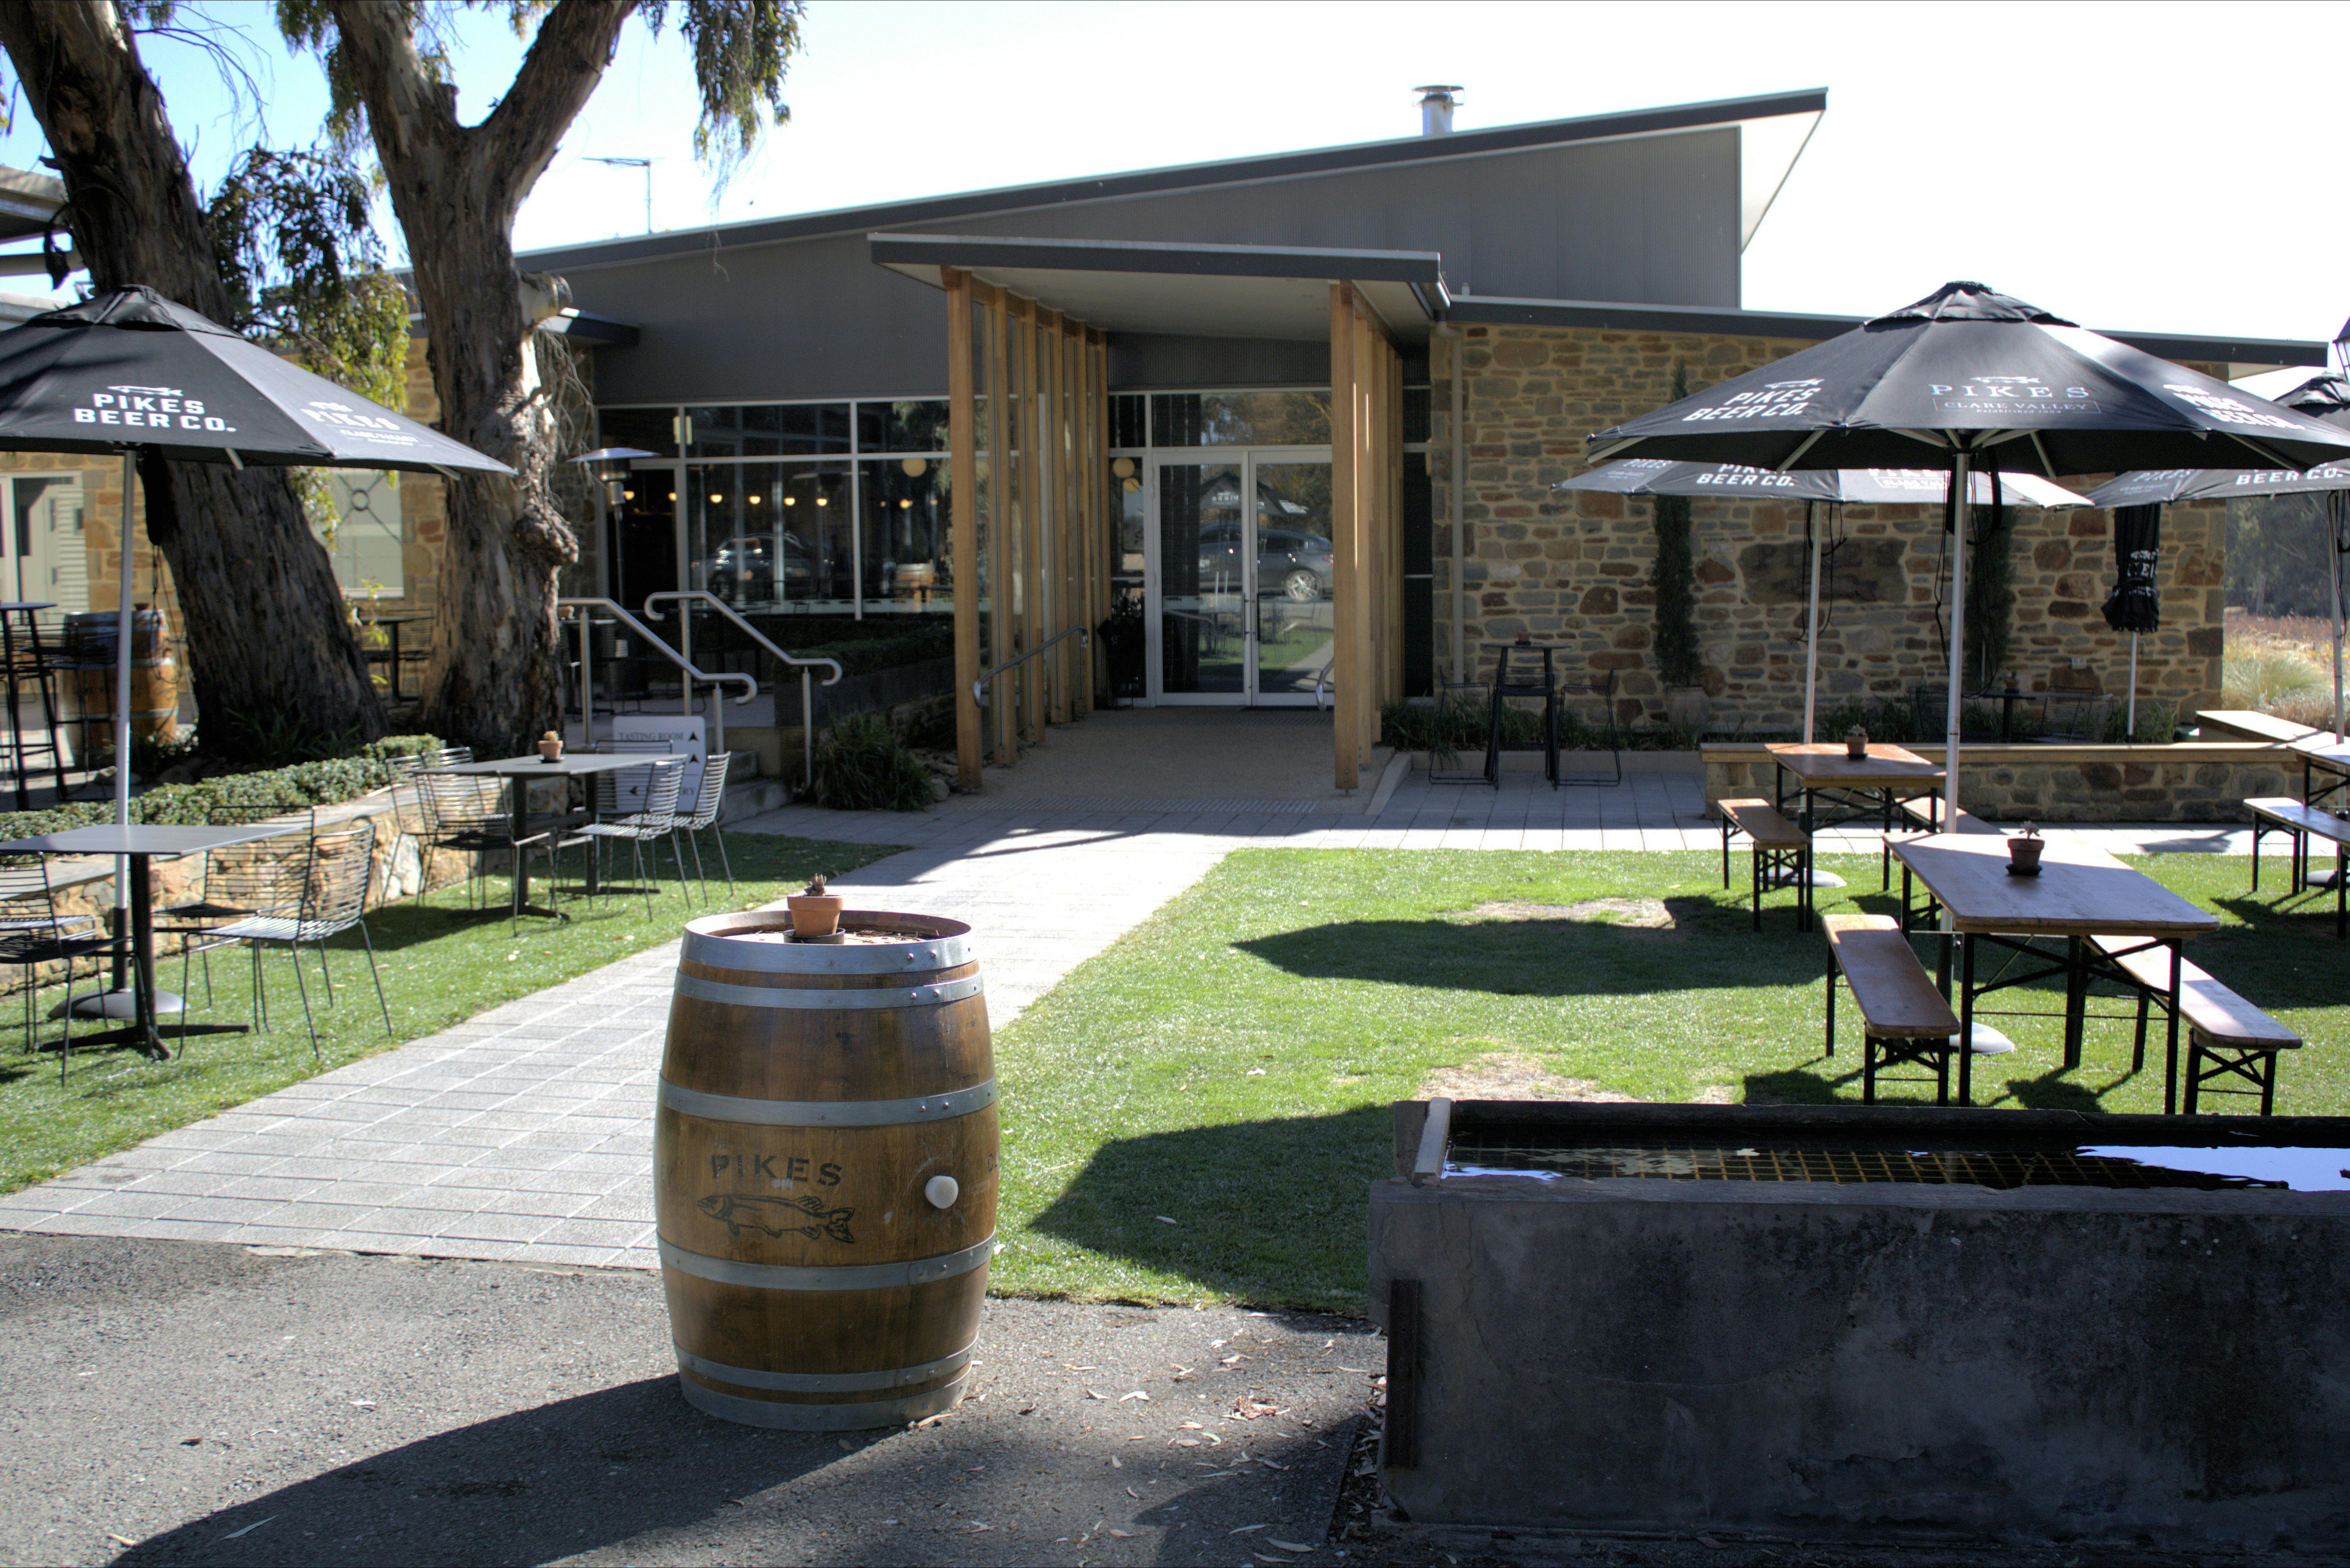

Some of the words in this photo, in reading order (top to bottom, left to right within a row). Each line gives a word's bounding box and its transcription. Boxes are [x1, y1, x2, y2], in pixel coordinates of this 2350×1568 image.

[1723, 388, 1821, 406] PIKES
[1929, 384, 2089, 398] PIKES
[93, 393, 205, 415] PIKES
[73, 408, 171, 428] BEER
[179, 415, 237, 432] CO.
[1682, 405, 1767, 421] BEER
[1696, 473, 1758, 485] BEER
[1761, 475, 1795, 486] CO.
[2236, 470, 2300, 485] BEER
[2306, 468, 2343, 480] CO.
[711, 1154, 842, 1186] PIKES
